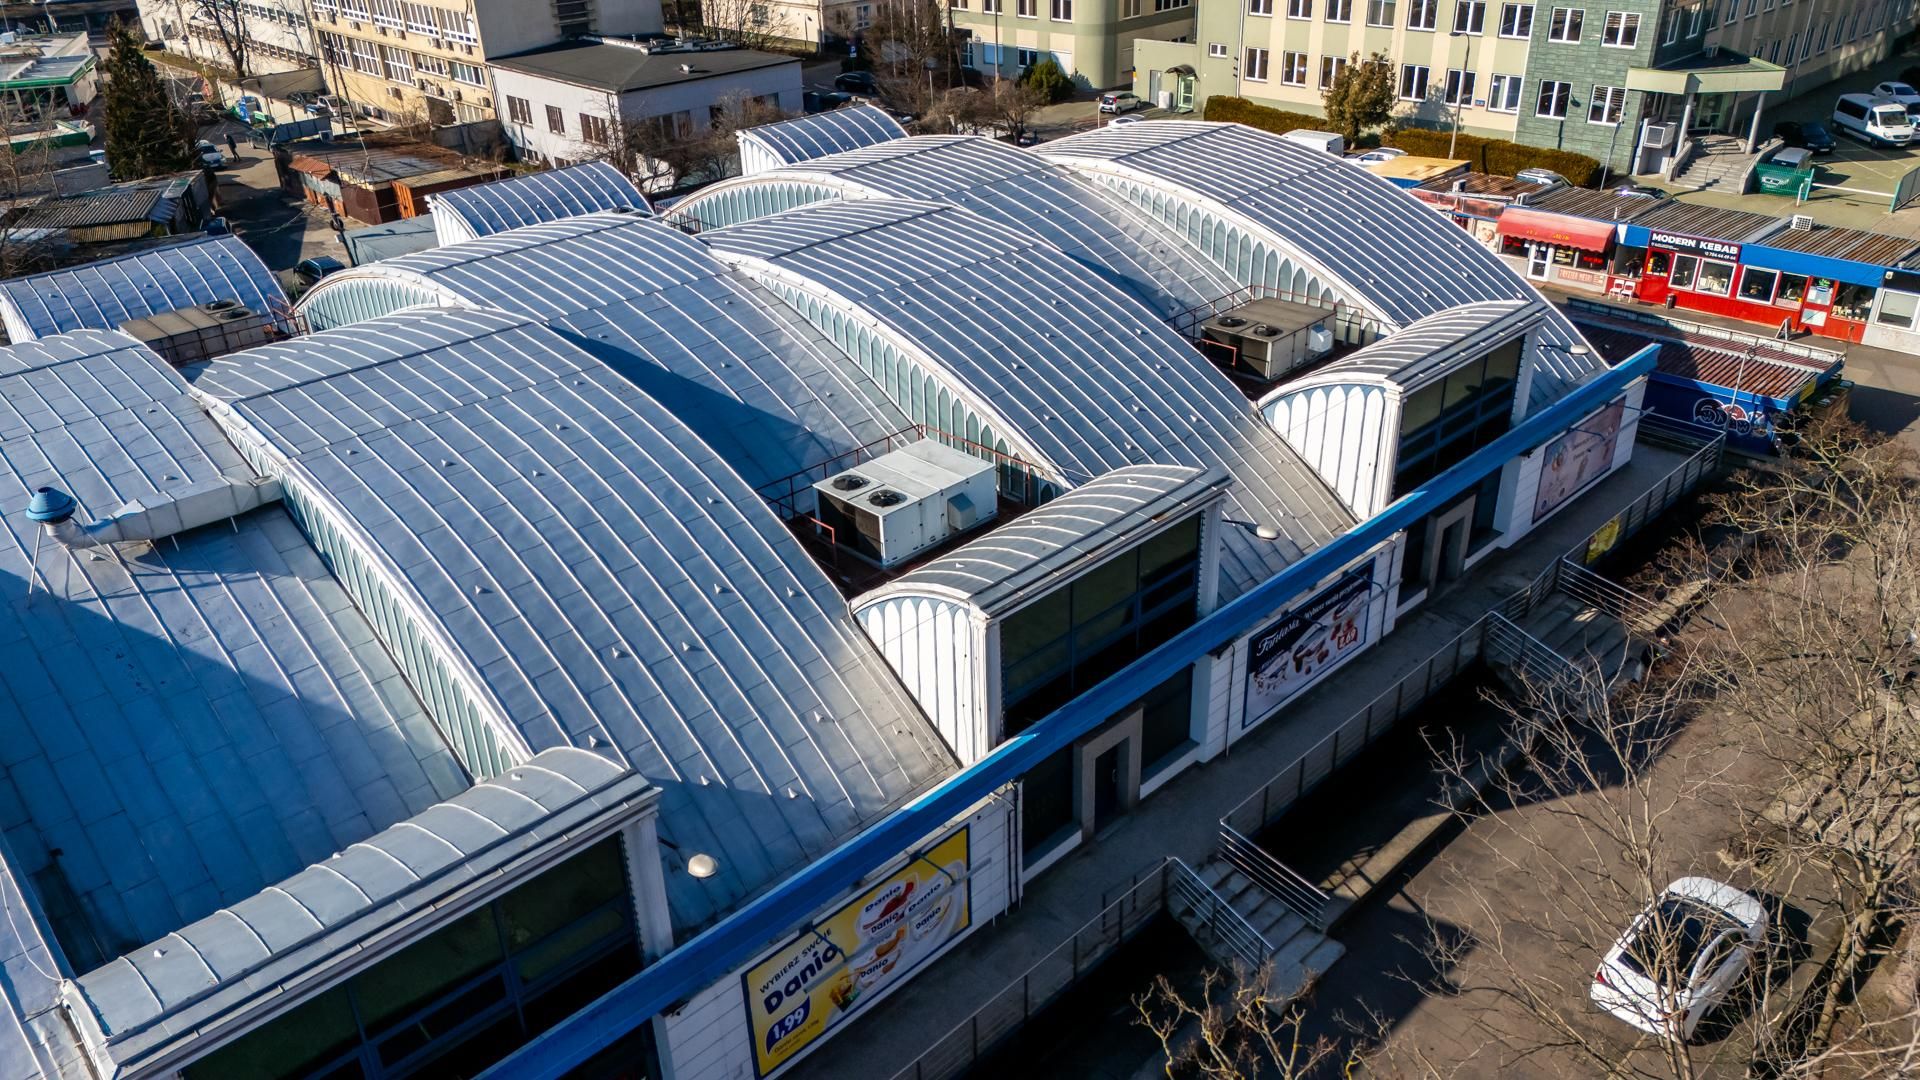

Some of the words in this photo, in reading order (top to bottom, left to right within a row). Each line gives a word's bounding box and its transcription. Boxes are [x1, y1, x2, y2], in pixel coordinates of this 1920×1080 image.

[1652, 233, 1697, 247] MODERN
[1699, 241, 1738, 254] KEBAB
[865, 886, 901, 913] Danio
[908, 883, 942, 913] Danio
[871, 912, 899, 933] Danio
[915, 906, 942, 930] Danio
[760, 956, 800, 994] WYBIERZ
[763, 944, 838, 1015] Danio
[860, 958, 889, 978] Danio
[773, 1007, 805, 1040] 1,99
